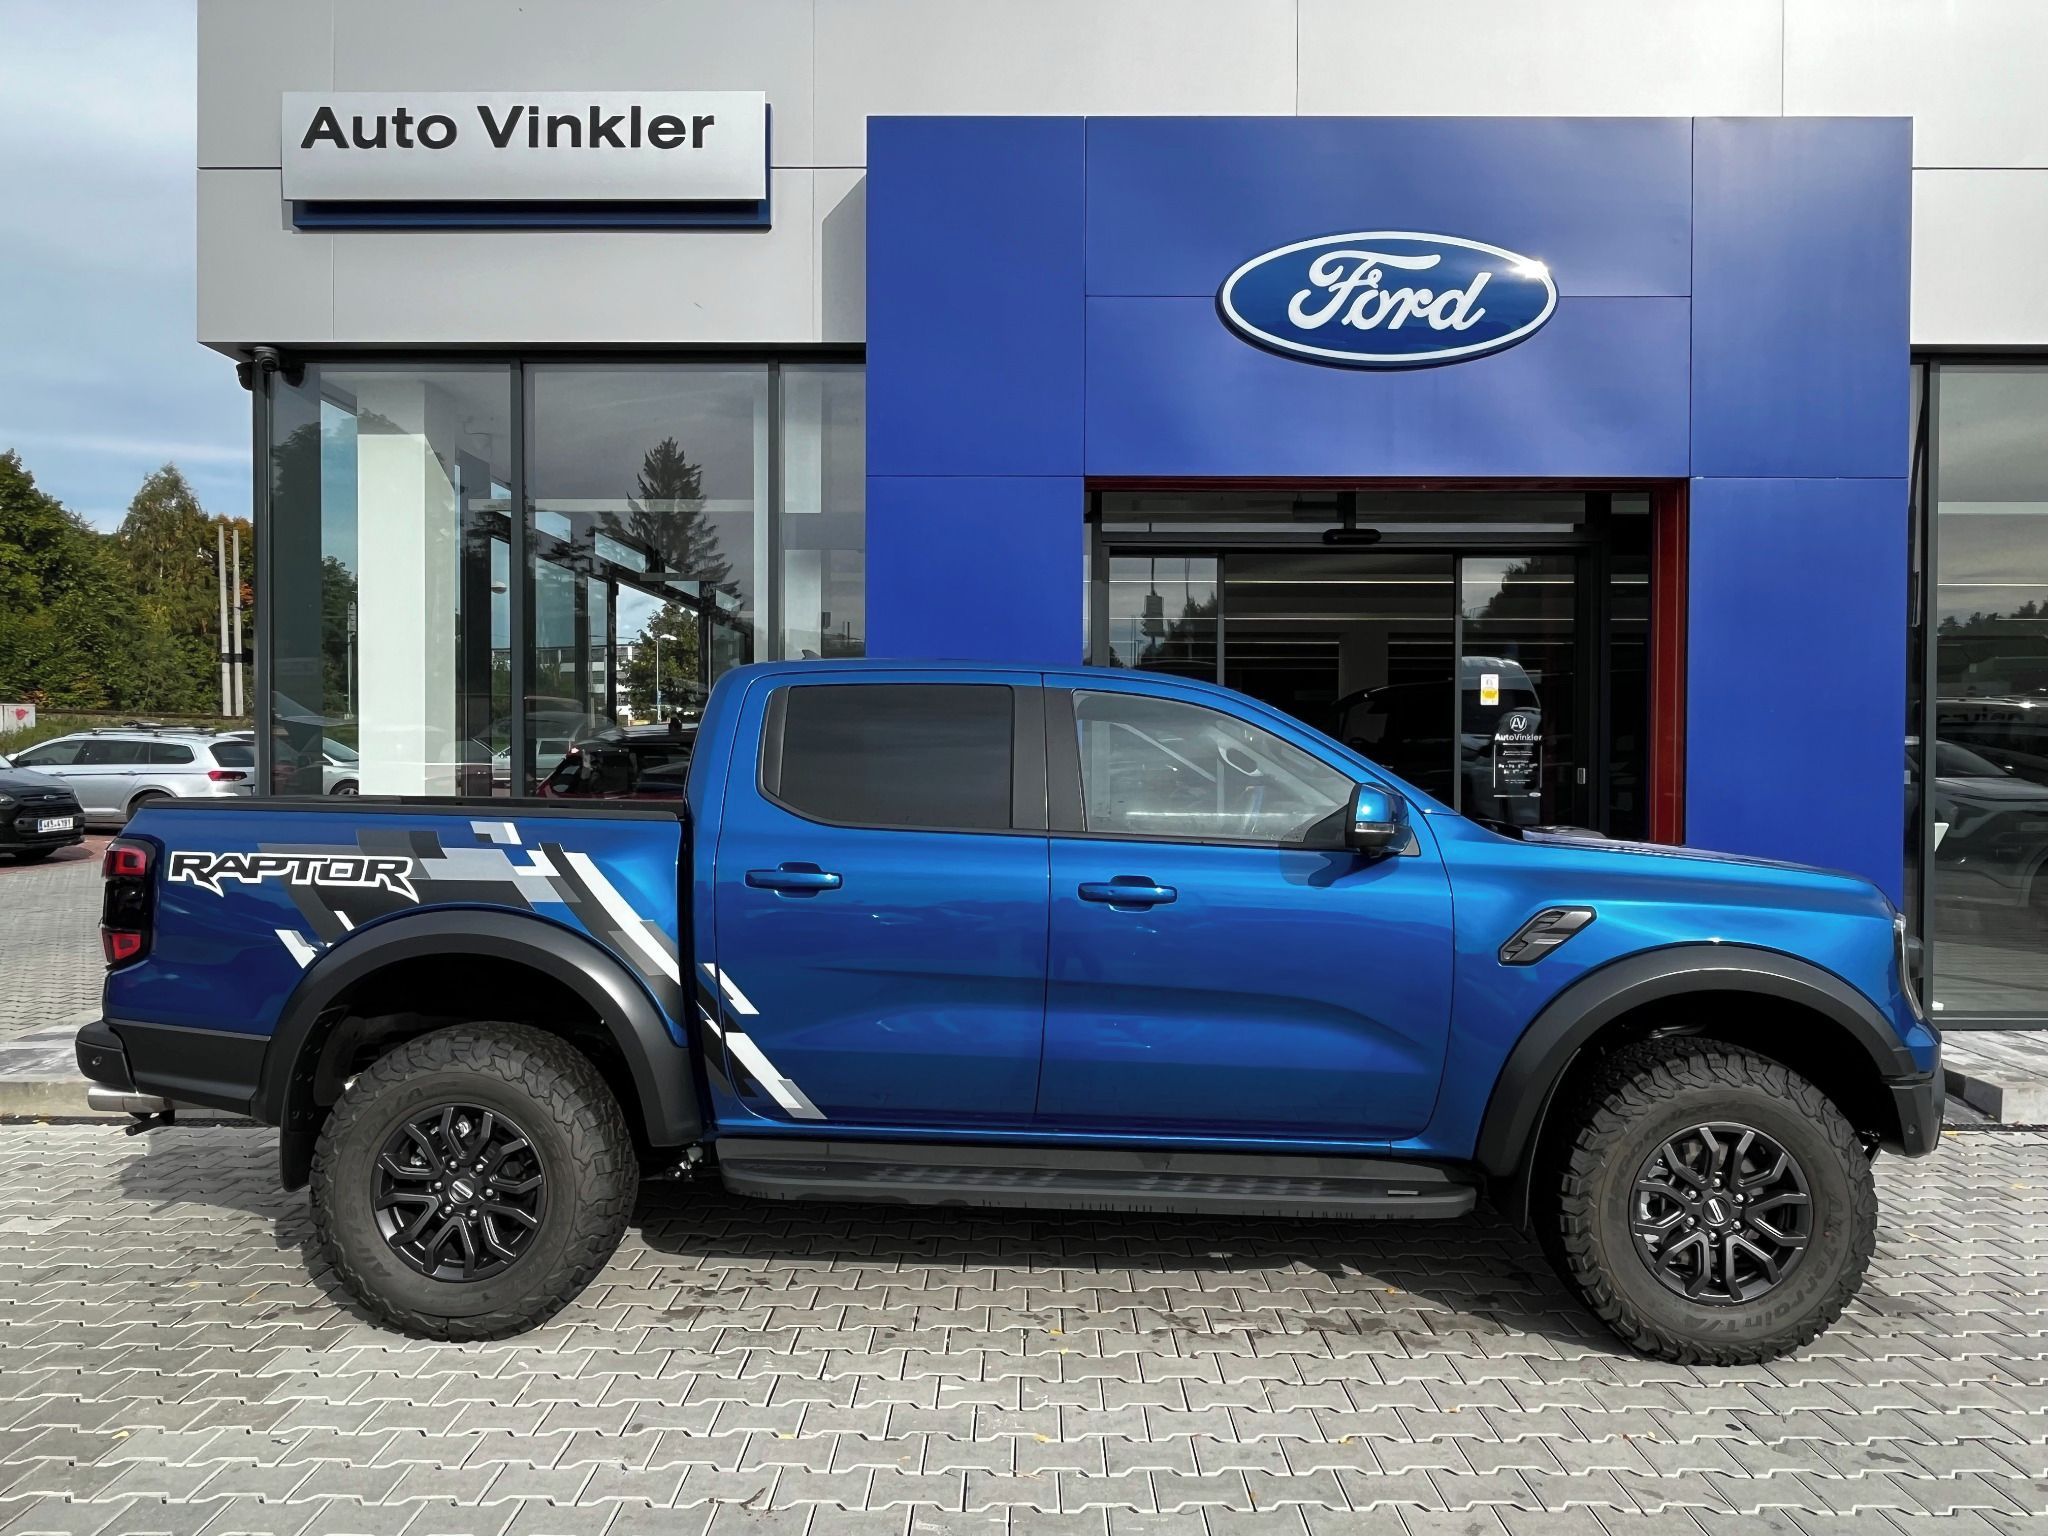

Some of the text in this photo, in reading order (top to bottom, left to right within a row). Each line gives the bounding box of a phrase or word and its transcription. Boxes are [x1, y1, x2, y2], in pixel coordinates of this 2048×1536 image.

[300, 105, 715, 149] Auto Vinkler
[1288, 250, 1492, 331] Ford
[168, 851, 420, 904] RAPTOR
